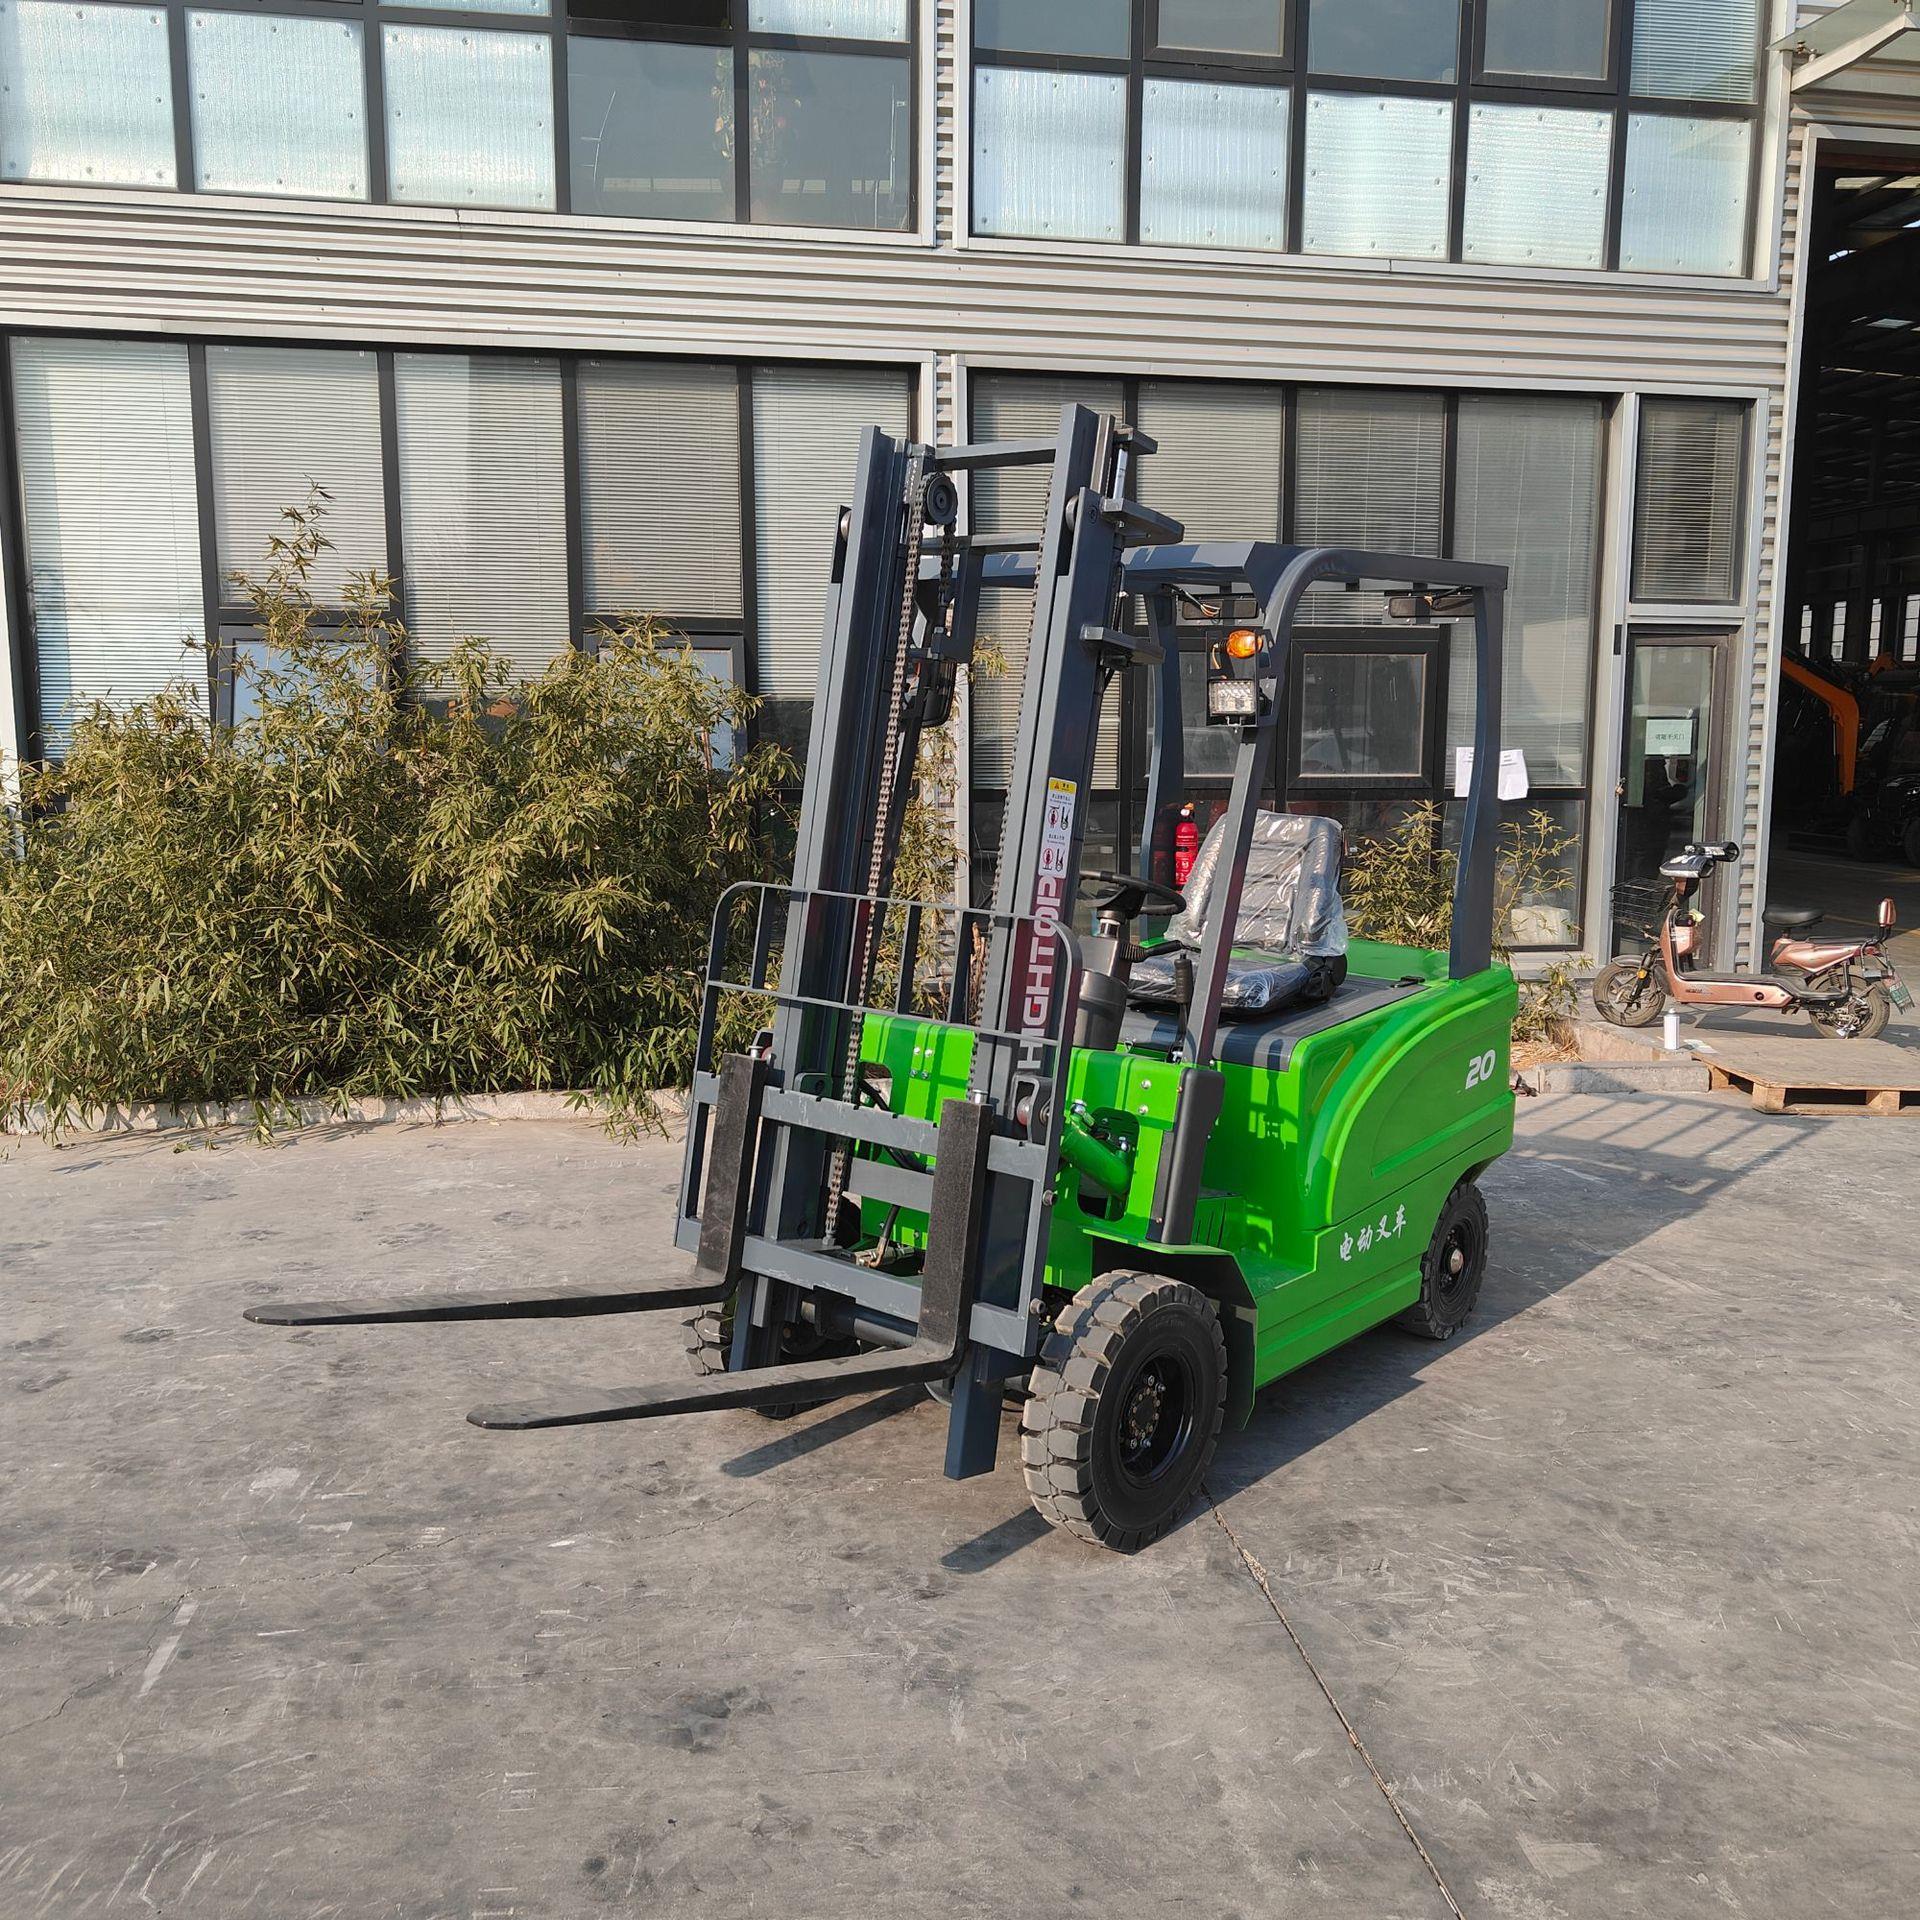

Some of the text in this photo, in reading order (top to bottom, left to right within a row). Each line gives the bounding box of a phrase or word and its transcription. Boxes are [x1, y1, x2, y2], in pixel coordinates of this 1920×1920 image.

[1017, 876, 1061, 1069] HIGHTOP
[1465, 1049, 1496, 1090] 20
[1339, 1203, 1407, 1262] 电动叉车
